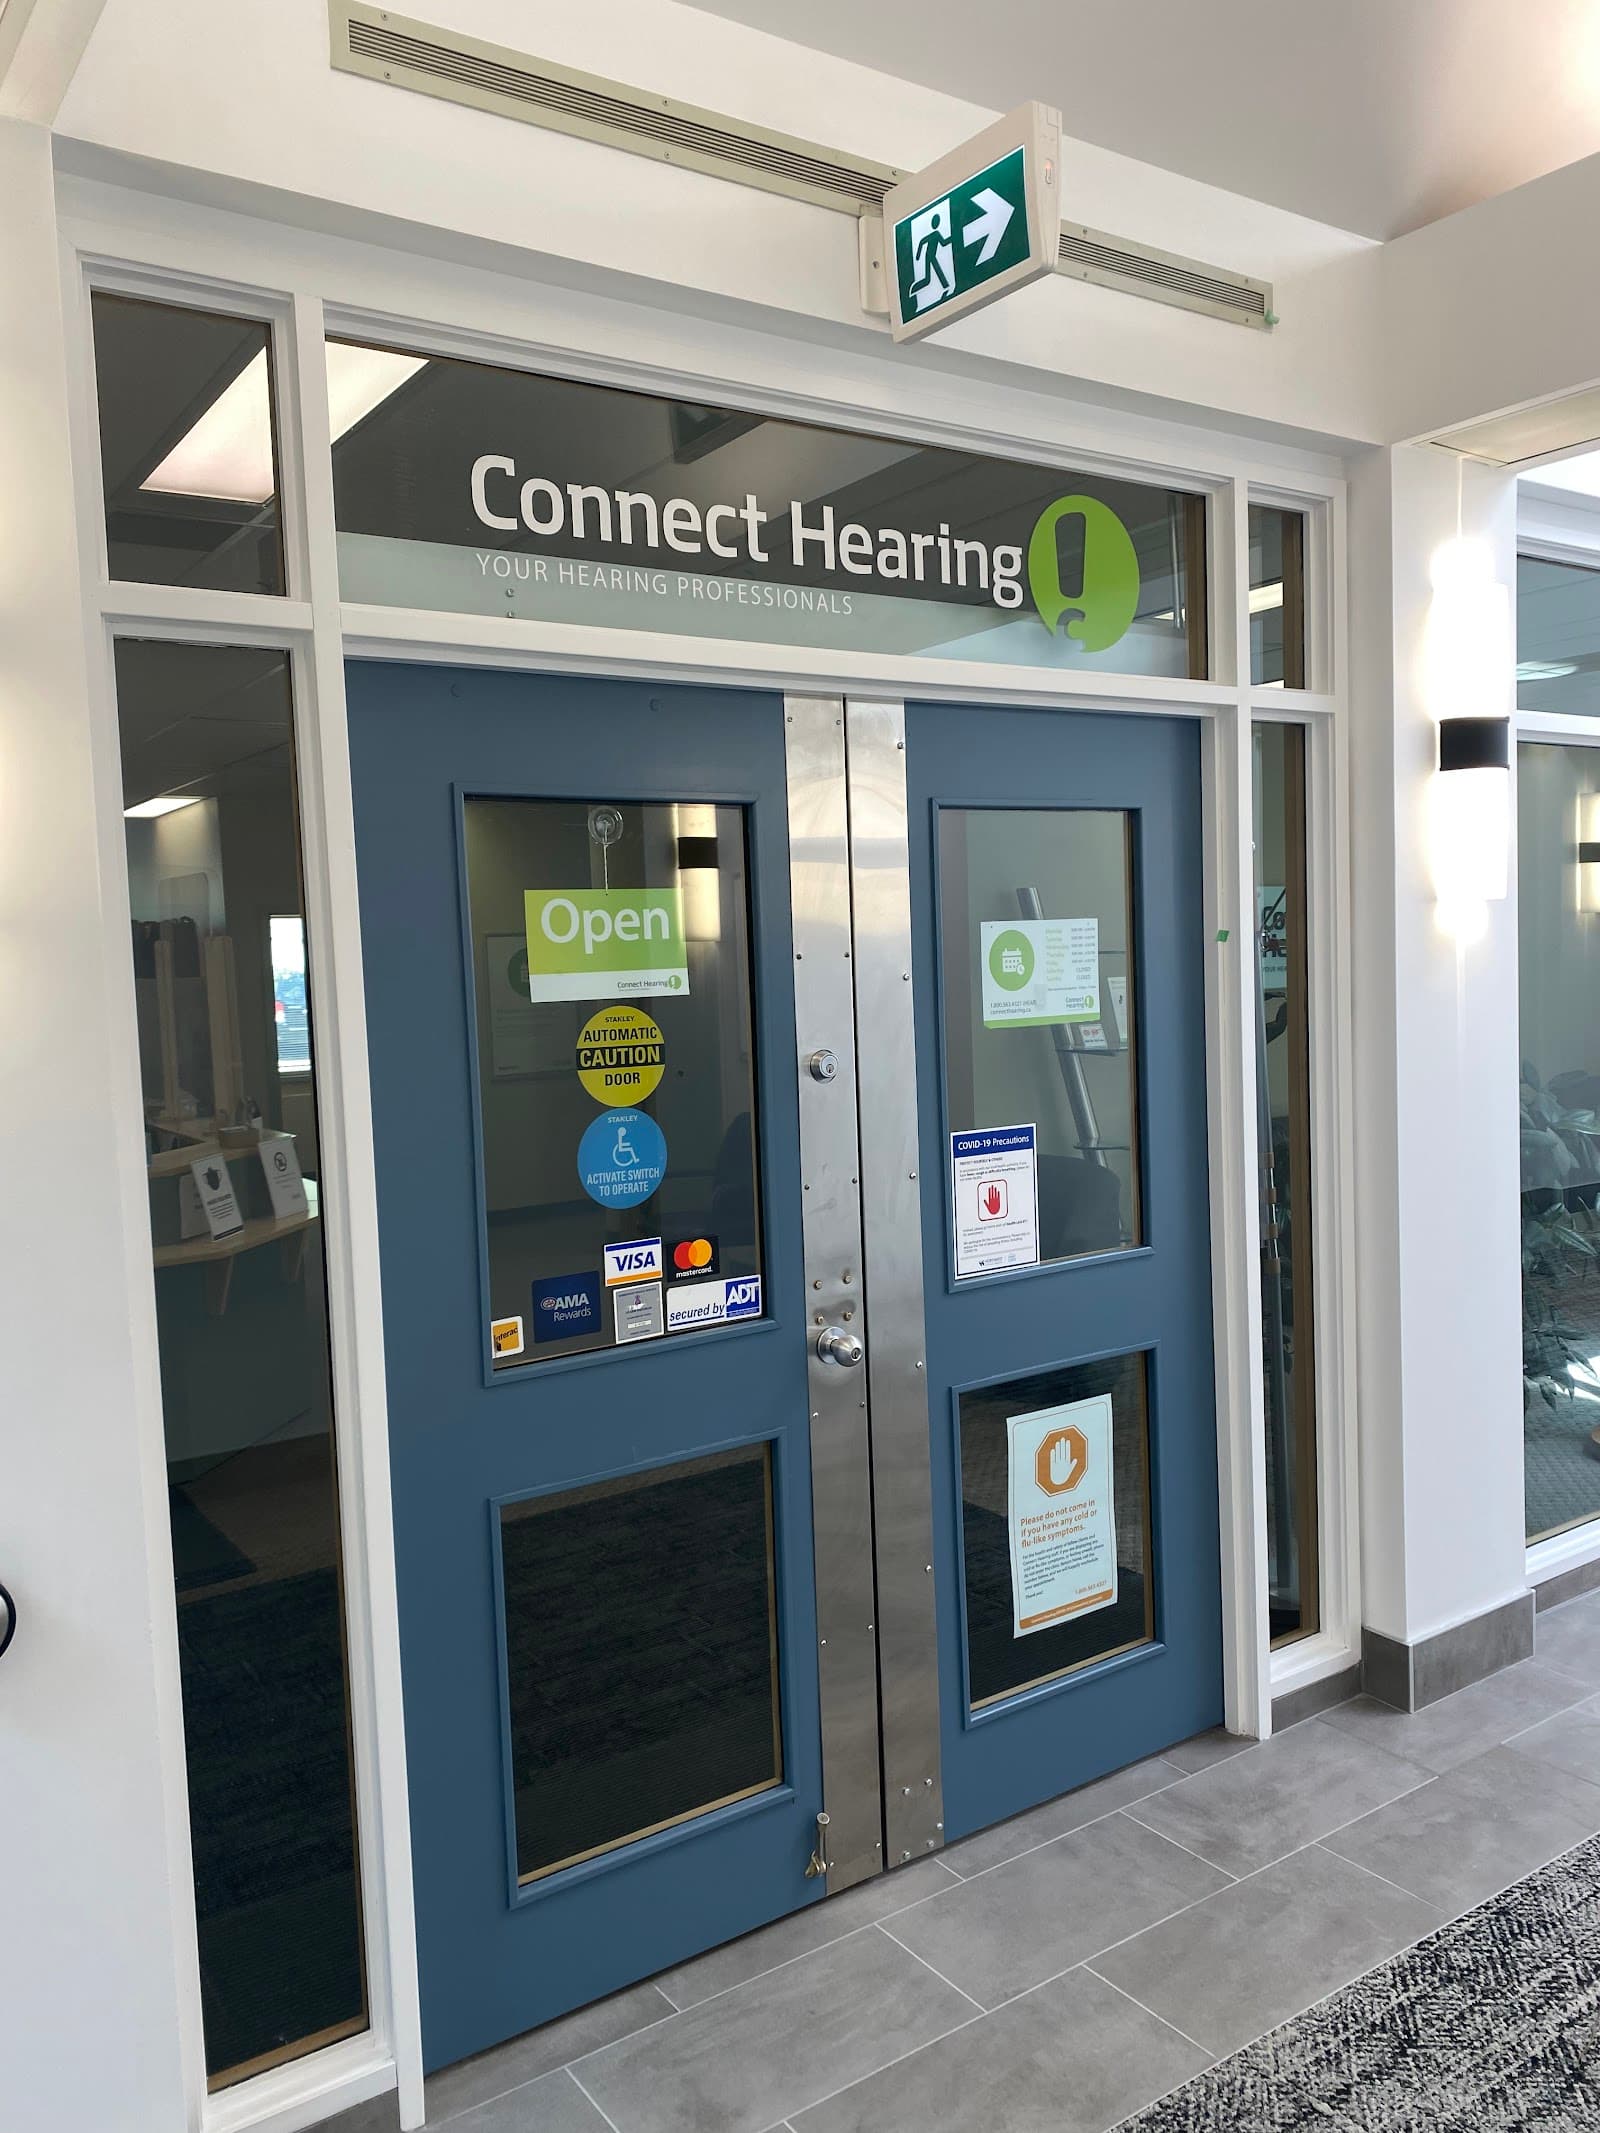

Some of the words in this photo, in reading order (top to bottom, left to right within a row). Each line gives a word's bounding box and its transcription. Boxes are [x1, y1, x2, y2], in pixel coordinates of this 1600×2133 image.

[471, 454, 769, 562] Connect
[791, 501, 1024, 609] Hearing
[476, 553, 548, 582] YOUR
[560, 563, 667, 595] HEARING
[678, 577, 852, 615] PROFESSIONALS
[541, 898, 670, 954] Open
[617, 980, 642, 989] Connect
[644, 979, 668, 989] Hearing
[605, 1015, 635, 1023] STANLEY
[583, 1026, 657, 1042] AUTOMATIC
[580, 1045, 660, 1067] CAUTION
[605, 1072, 640, 1086] DOOR
[608, 1115, 638, 1123] STANLEY
[958, 1139, 991, 1151] COVID-19
[992, 1135, 1030, 1148] Precautions
[587, 1170, 627, 1185] ACTIVATE
[628, 1167, 660, 1181] SWITCH
[599, 1185, 610, 1197] TO
[612, 1181, 649, 1195] OPERATE
[612, 1251, 655, 1272] VISA
[554, 1293, 589, 1311] AMA
[727, 1282, 760, 1306] ADT
[553, 1306, 592, 1322] Rewards
[669, 1303, 709, 1322] secured
[712, 1302, 725, 1315] by
[1020, 1515, 1043, 1527] Please
[1045, 1511, 1054, 1520] do
[1056, 1507, 1068, 1517] not
[1069, 1502, 1087, 1513] come
[1088, 1498, 1095, 1508] in
[1021, 1527, 1027, 1538] if
[1027, 1525, 1041, 1537] you
[1042, 1519, 1059, 1531] have
[1060, 1516, 1073, 1528] any
[1074, 1511, 1089, 1523] cold
[1090, 1509, 1097, 1518] or
[1021, 1534, 1047, 1549] flu-like
[1047, 1525, 1085, 1542] symptoms.
